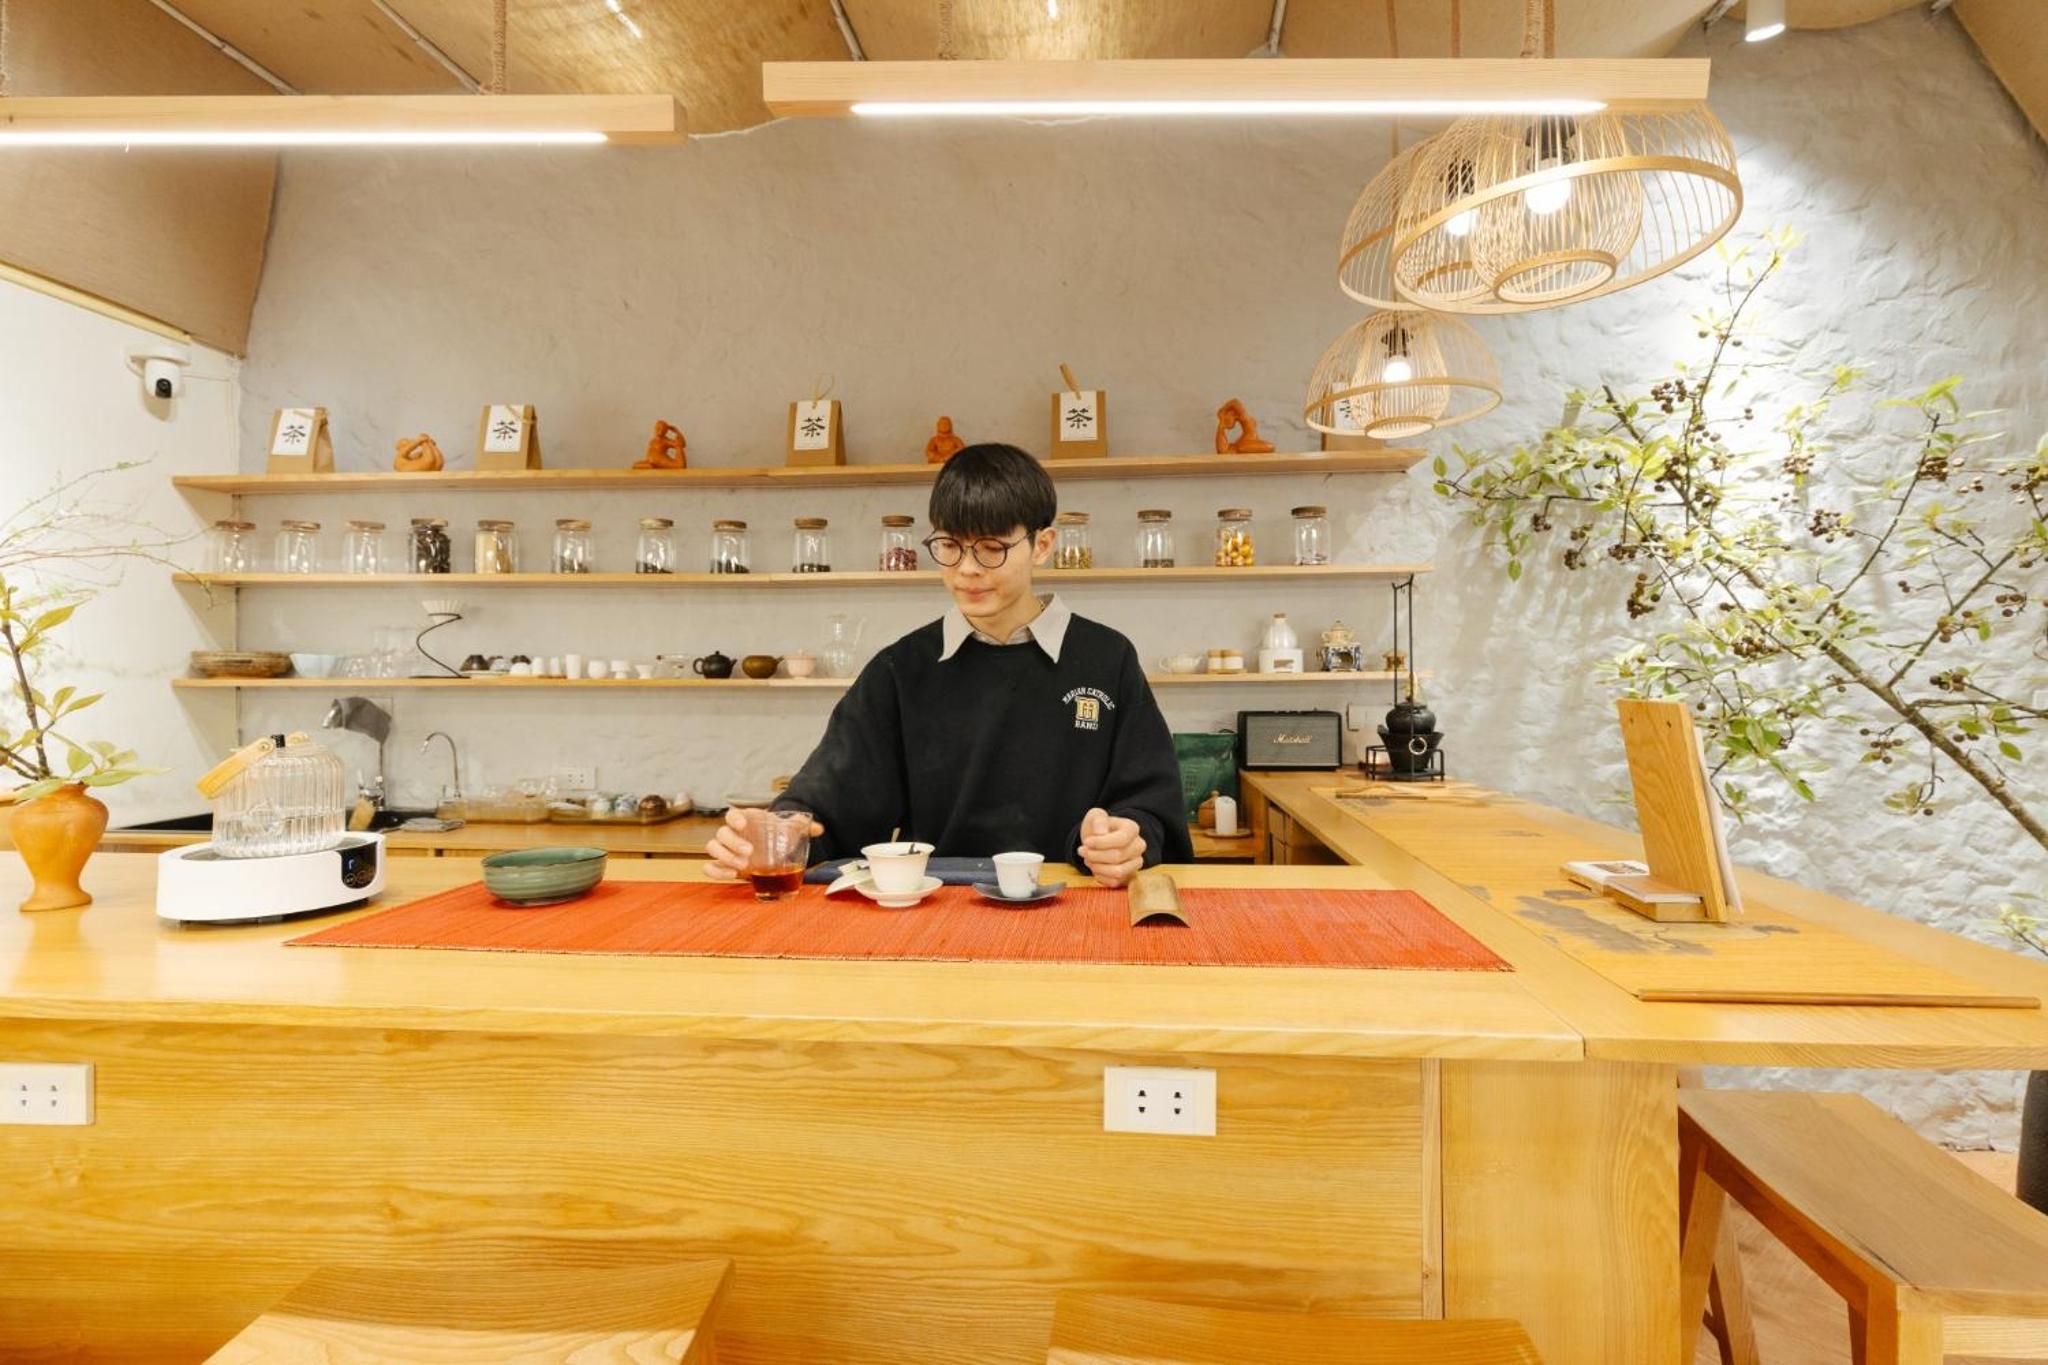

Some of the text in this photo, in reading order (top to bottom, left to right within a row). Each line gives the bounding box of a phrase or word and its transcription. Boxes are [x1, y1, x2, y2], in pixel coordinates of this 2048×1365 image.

[801, 416, 825, 438] 茶
[1066, 408, 1093, 429] 茶
[282, 425, 306, 445] 茶
[493, 420, 520, 440] 茶
[1273, 733, 1312, 744] Marshall
